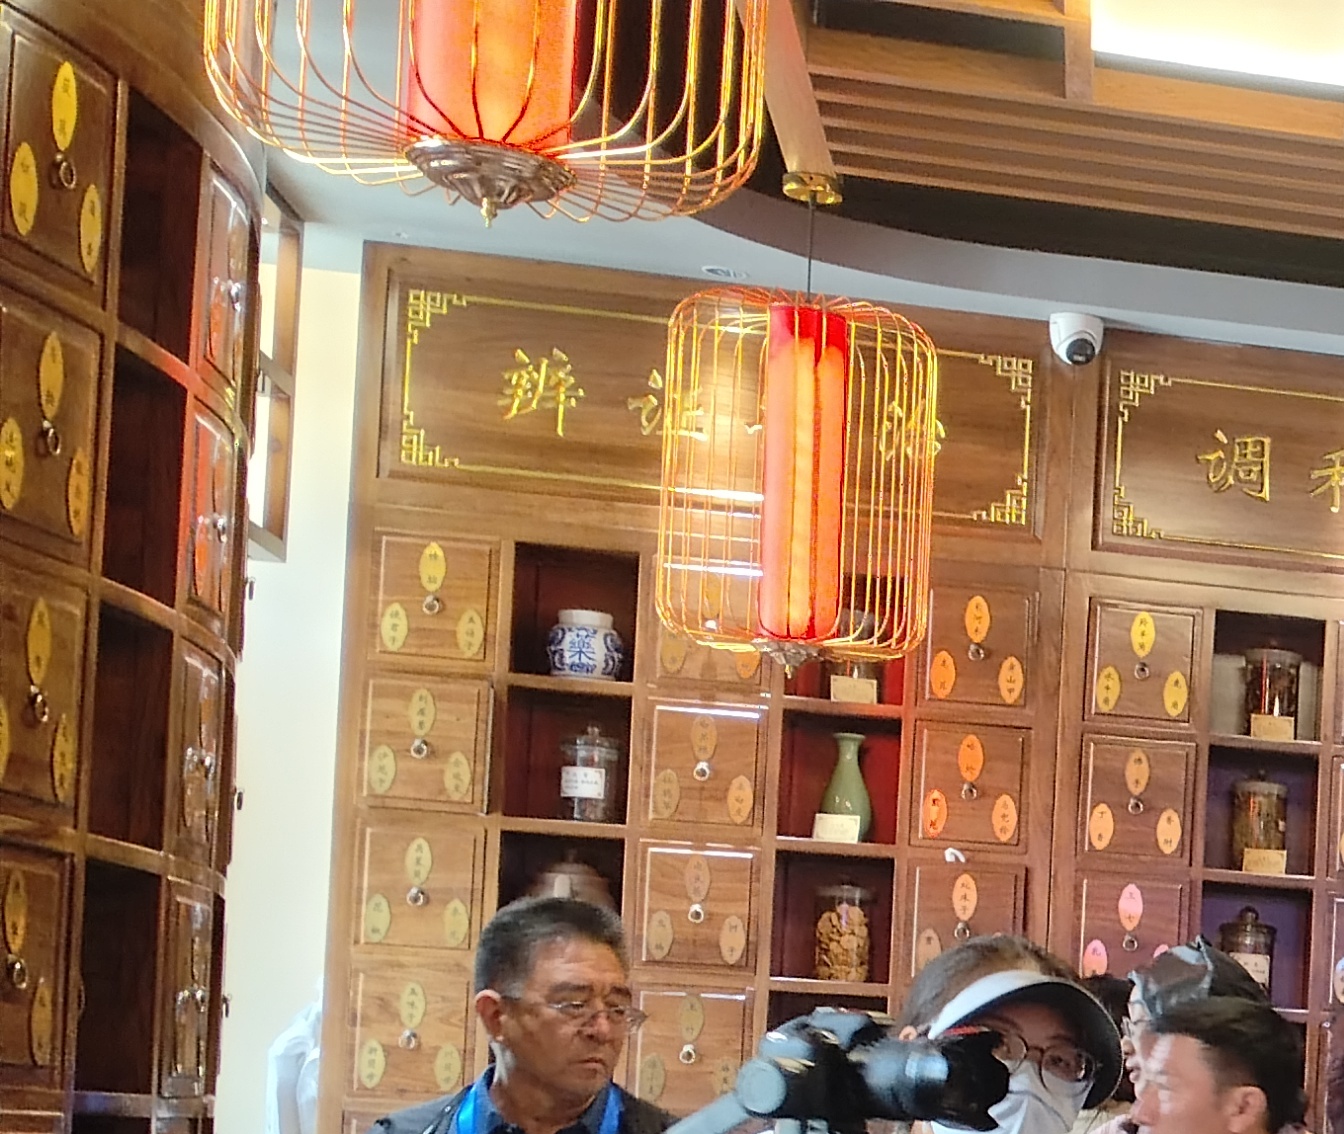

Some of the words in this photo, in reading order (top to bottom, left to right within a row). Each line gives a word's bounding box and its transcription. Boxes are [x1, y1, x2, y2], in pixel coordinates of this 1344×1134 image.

[1137, 617, 1149, 652] 羚羊角
[1101, 671, 1114, 707] 水牛角
[1095, 810, 1107, 843] 丁香
[1162, 814, 1175, 848] 香附
[1124, 890, 1137, 924] 三七
